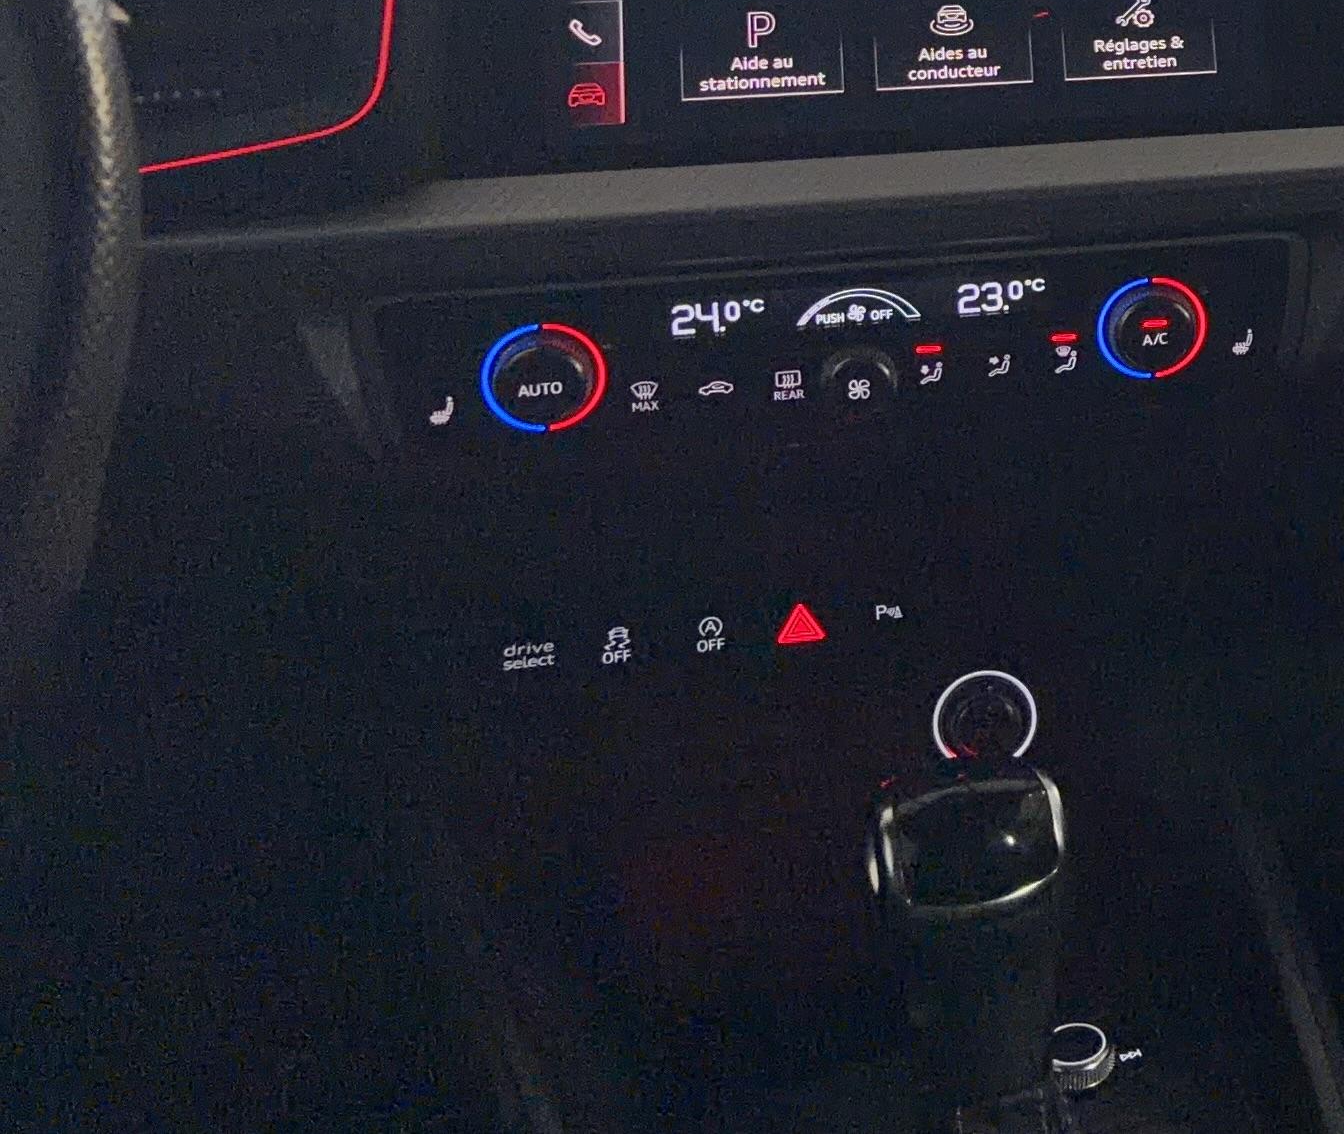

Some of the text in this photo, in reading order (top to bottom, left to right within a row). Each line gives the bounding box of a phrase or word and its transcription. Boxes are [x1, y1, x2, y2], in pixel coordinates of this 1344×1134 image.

[917, 45, 989, 62] Aides au
[1093, 35, 1186, 56] Réglages &
[730, 55, 794, 72] Aide au
[1102, 55, 1177, 71] entretien
[699, 71, 827, 90] stationnement
[907, 63, 1001, 82] conducteur
[815, 308, 894, 326] PUSH OFF
[1142, 331, 1168, 348] A/C
[517, 381, 563, 399] AUTO
[773, 389, 805, 401] REAR
[631, 400, 660, 413] MAX
[502, 641, 555, 657] drive
[696, 637, 725, 653] OFF
[502, 652, 556, 670] select
[601, 648, 632, 665] OFF
